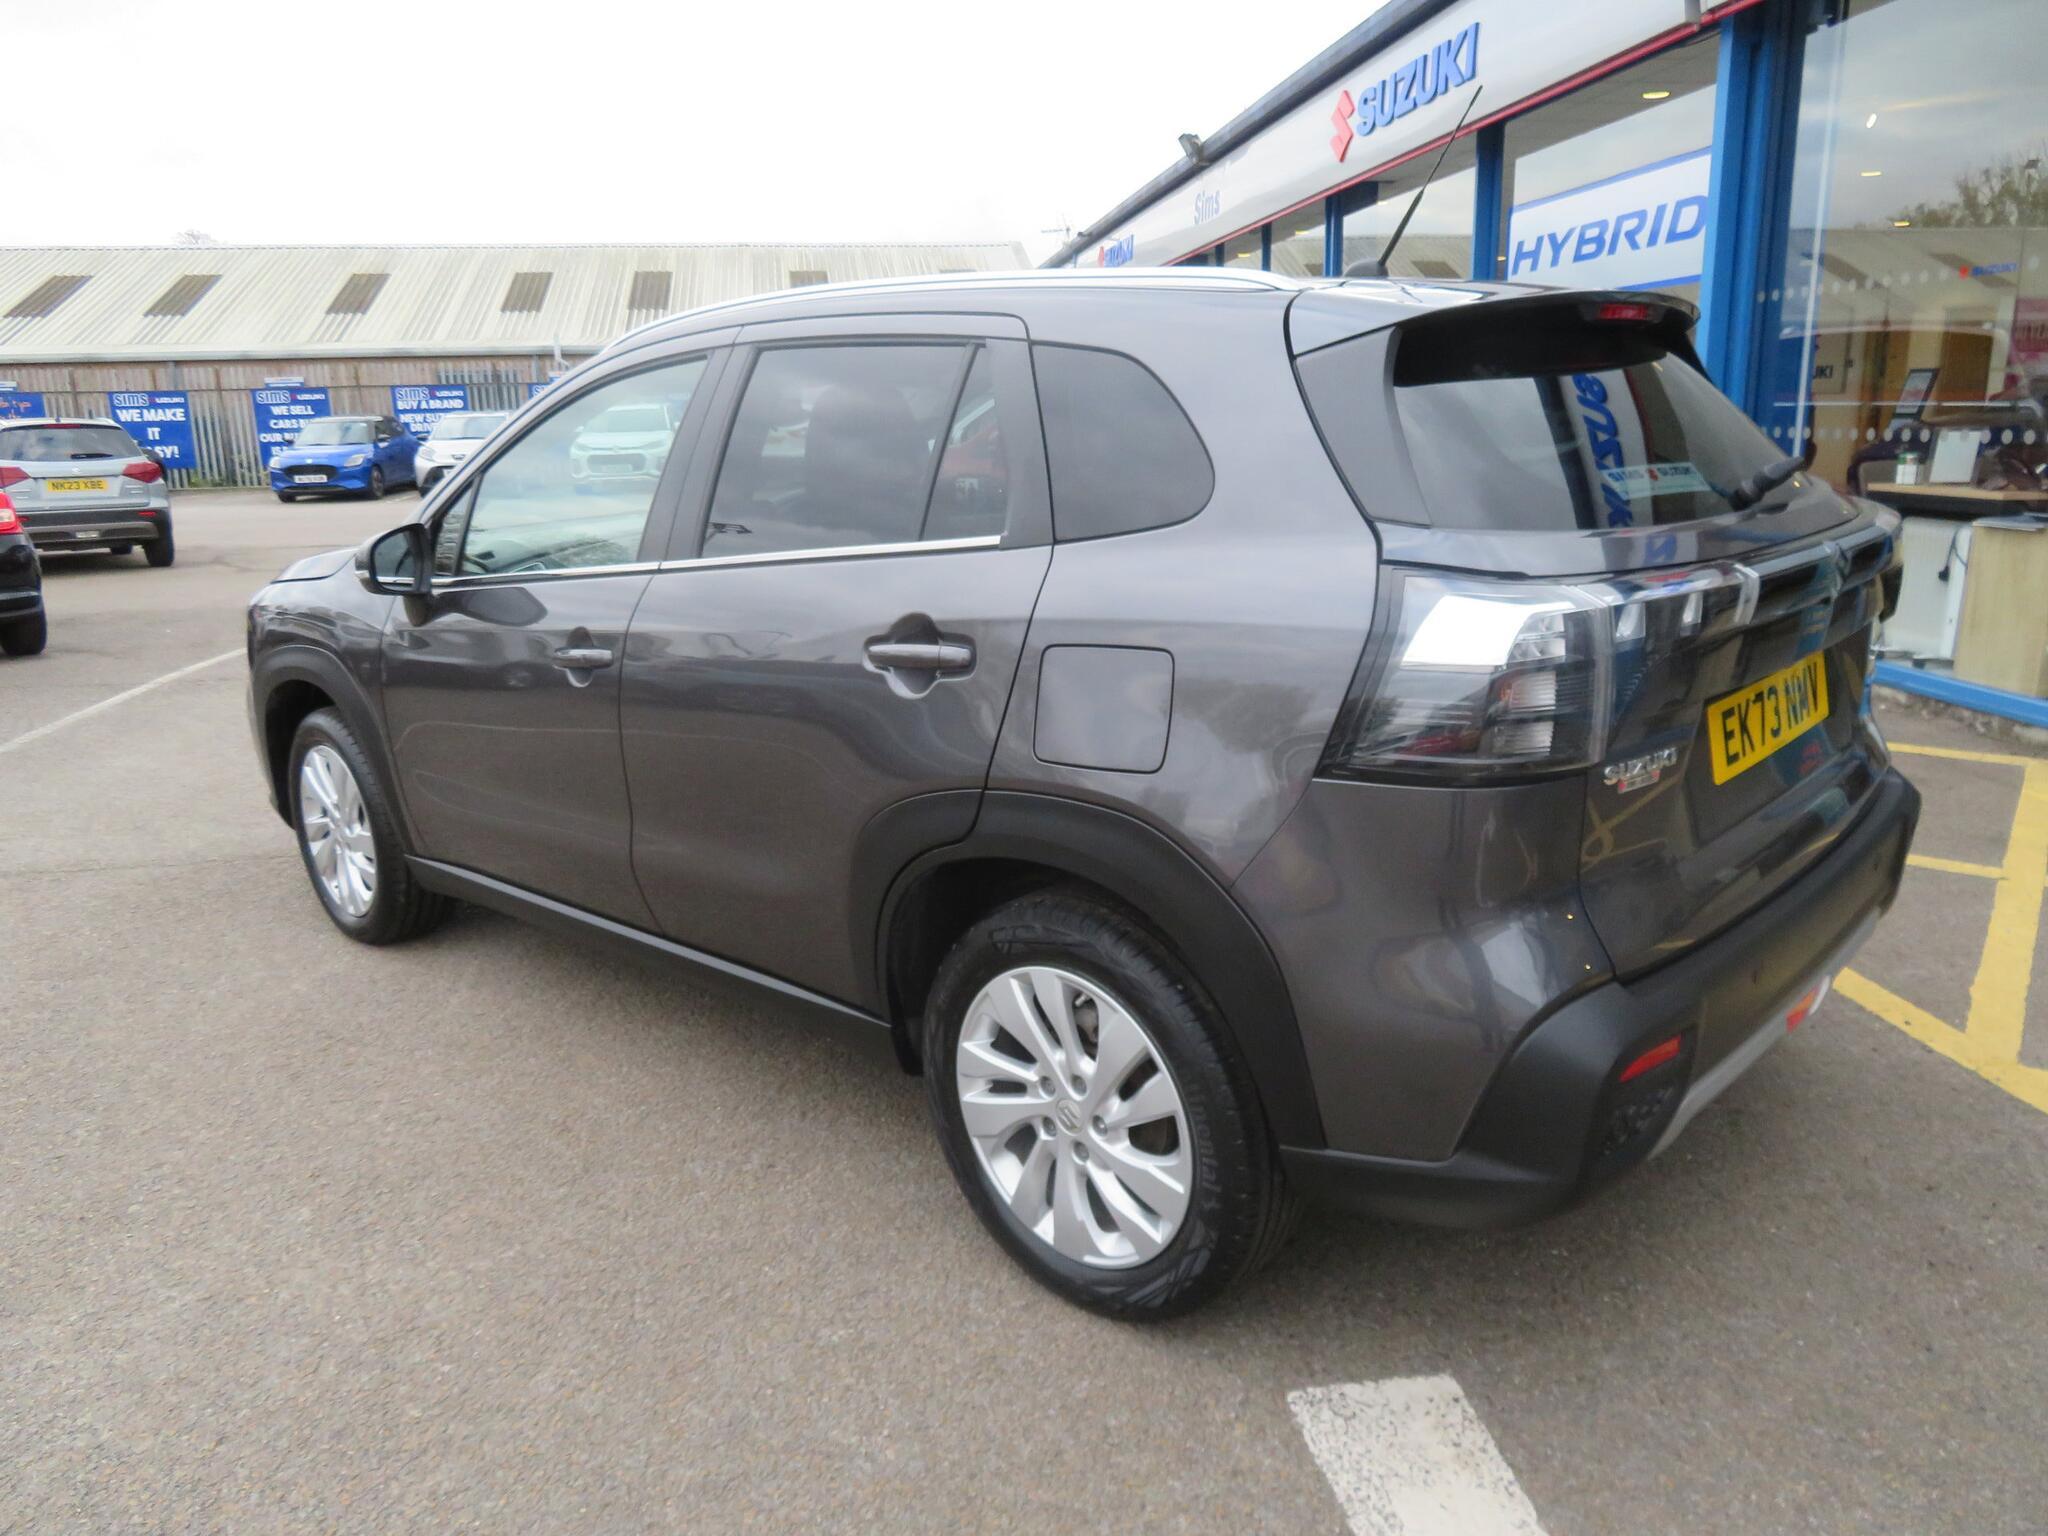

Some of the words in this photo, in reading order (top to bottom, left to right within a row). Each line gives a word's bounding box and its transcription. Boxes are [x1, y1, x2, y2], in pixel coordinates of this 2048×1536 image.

[1356, 22, 1480, 137] SUZUKI
[1194, 190, 1220, 225] Sims
[1511, 195, 1709, 276] HYBRID
[270, 405, 289, 415] WE
[290, 405, 315, 415] SELL
[397, 400, 418, 410] BUY
[420, 400, 428, 409] A
[429, 399, 464, 409] BRAND
[115, 409, 142, 422] WE
[143, 408, 186, 421] MAKE
[399, 413, 424, 424] NEW
[269, 419, 298, 429] CARS
[147, 427, 161, 441] IT
[260, 433, 283, 443] OUR
[1720, 687, 1782, 767] EK73
[1603, 747, 1678, 786] SUZUKI
